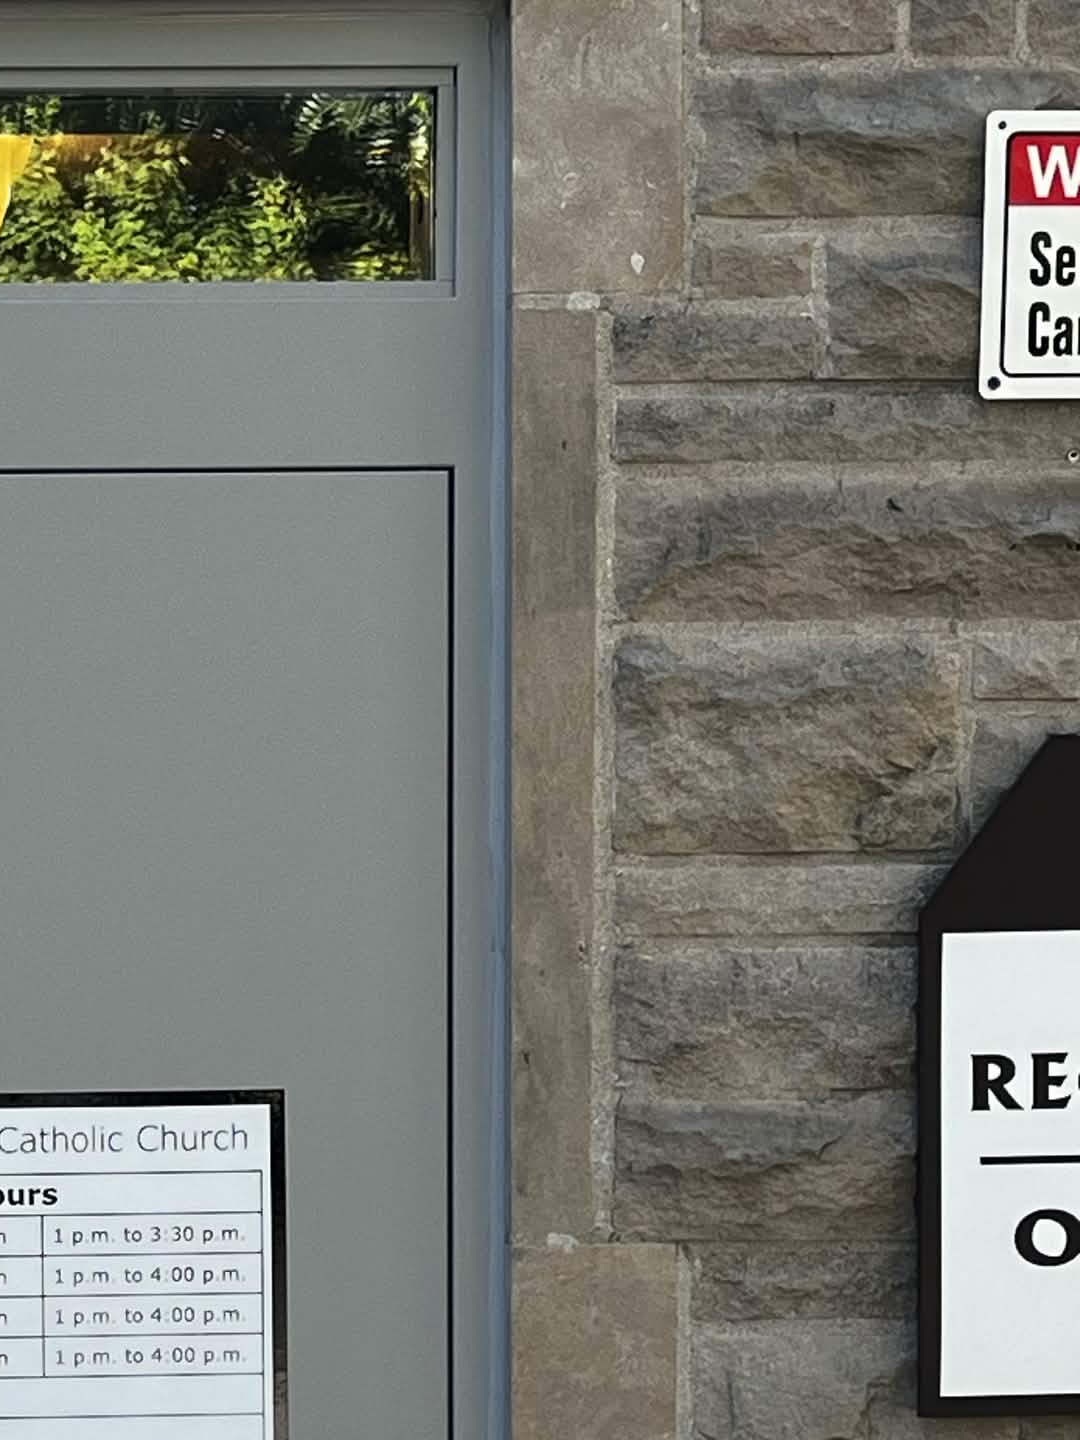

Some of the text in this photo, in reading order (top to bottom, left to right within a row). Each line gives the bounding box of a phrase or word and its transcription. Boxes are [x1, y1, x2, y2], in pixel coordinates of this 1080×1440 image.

[1027, 145, 1080, 199] W
[1029, 231, 1077, 287] Se
[1028, 301, 1080, 358] Ca
[970, 1052, 1080, 1112] RE
[136, 1122, 249, 1153] Church
[53, 1225, 246, 1247] 1 p.m. to 3:30 p.m.
[1014, 1208, 1080, 1268] O
[55, 1265, 247, 1288] 1 p.m. to 4:00 p.m.
[55, 1306, 247, 1329] 1 p.m. to 4:00 p.m.
[55, 1346, 247, 1369] 1 p.m. to 4:00 p.m.
